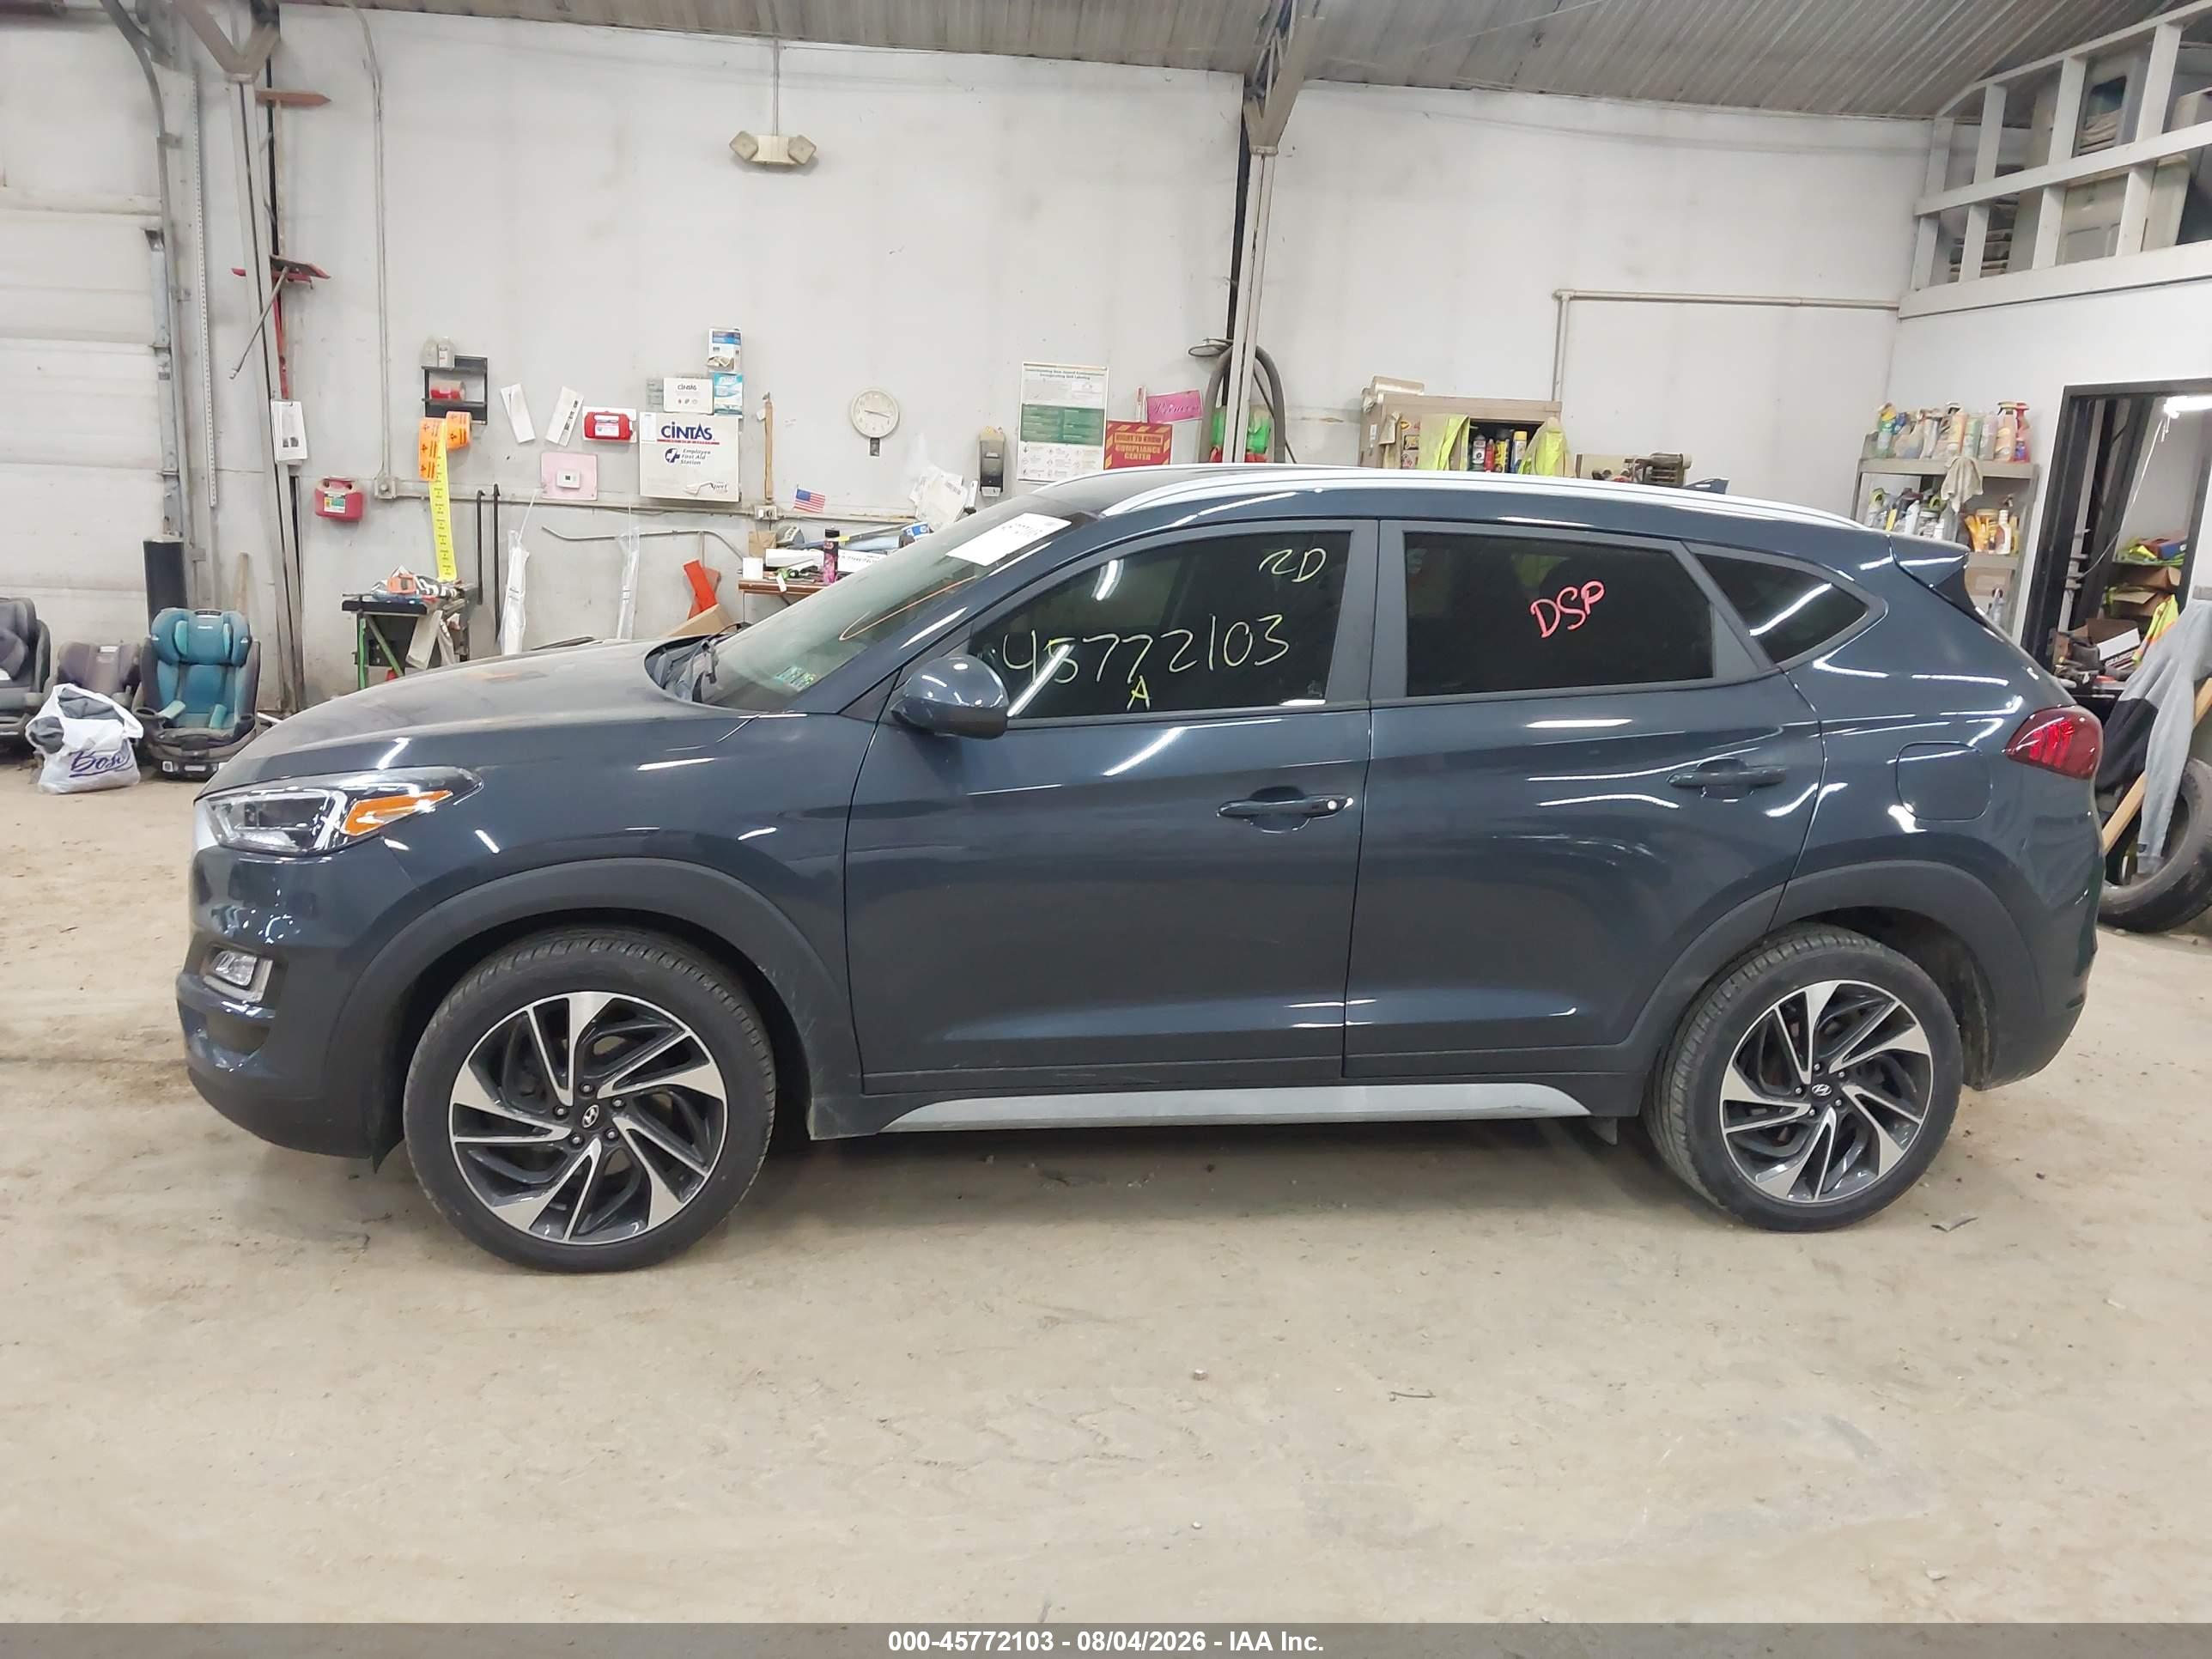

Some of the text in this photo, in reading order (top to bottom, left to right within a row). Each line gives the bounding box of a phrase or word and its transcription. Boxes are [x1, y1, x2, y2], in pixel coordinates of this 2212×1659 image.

[660, 421, 714, 441] CINTAS
[1530, 580, 1605, 638] DSP
[1003, 614, 1290, 685] 45772103
[1127, 676, 1150, 710] A
